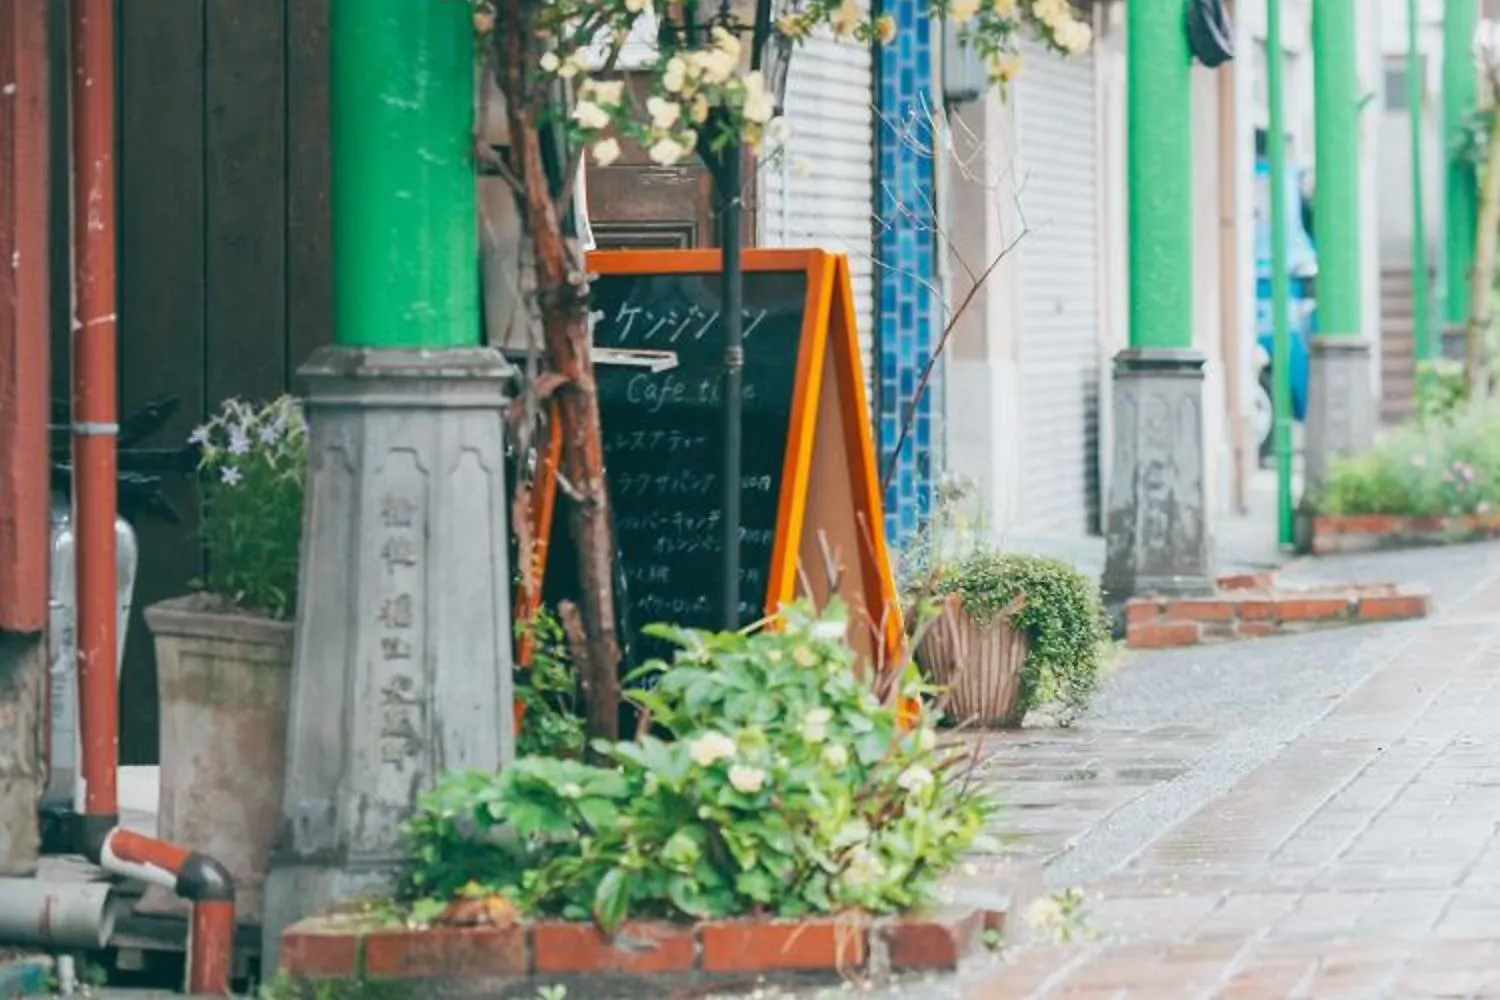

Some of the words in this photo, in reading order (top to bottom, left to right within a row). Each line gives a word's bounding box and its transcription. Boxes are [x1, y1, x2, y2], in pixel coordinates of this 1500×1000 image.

[615, 301, 767, 343] ケンジンン
[627, 373, 686, 413] Cafe
[699, 379, 756, 403] tie
